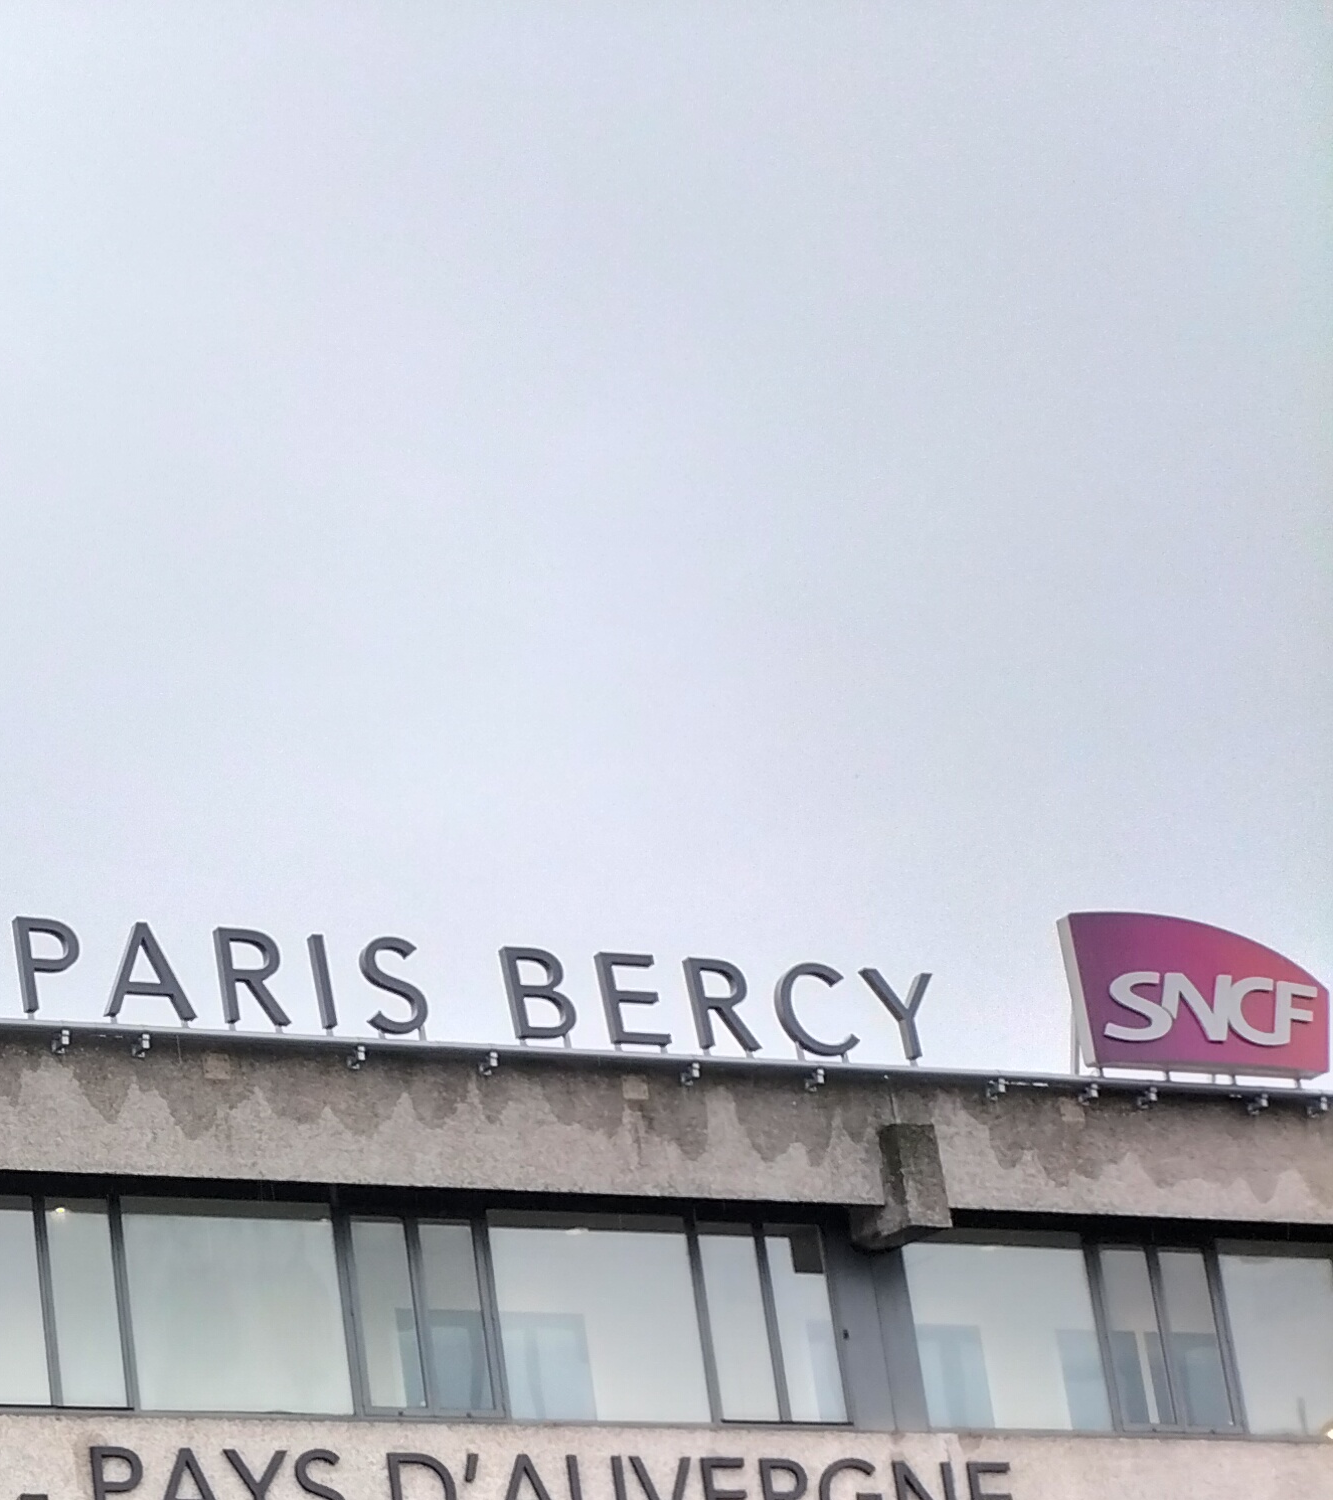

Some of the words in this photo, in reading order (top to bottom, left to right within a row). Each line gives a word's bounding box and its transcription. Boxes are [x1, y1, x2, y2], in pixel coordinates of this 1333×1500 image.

[11, 915, 430, 1035] PARIS
[498, 944, 933, 1061] BERCY
[1104, 968, 1319, 1049] SNCF
